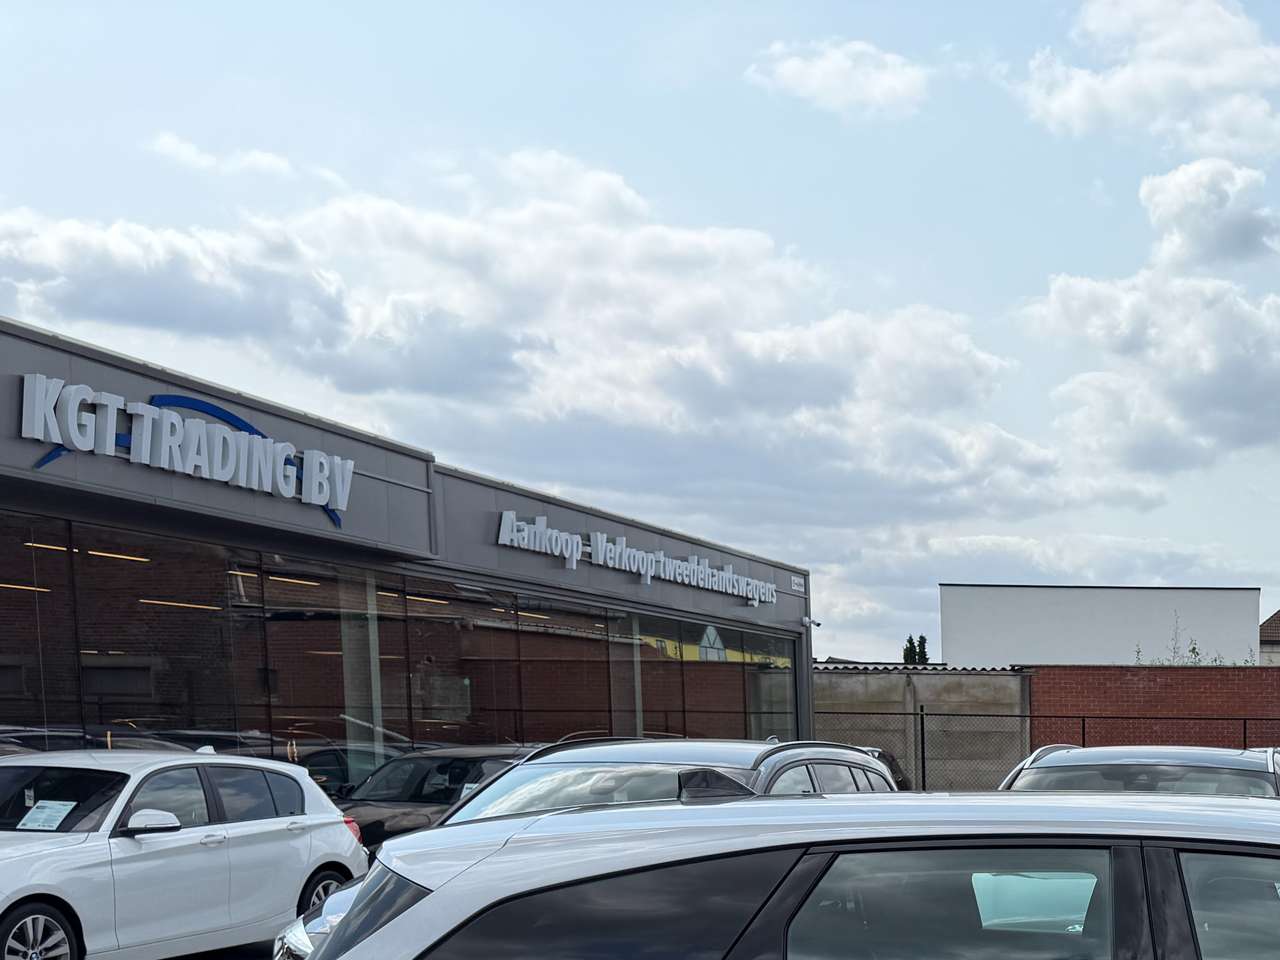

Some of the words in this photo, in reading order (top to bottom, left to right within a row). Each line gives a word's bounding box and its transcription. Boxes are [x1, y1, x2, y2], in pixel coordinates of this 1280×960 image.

[21, 373, 125, 457] KGT
[127, 402, 297, 498] TRADING
[301, 449, 355, 511] BV
[590, 532, 656, 585] Verkoop
[655, 550, 778, 607] tweedehandswagens
